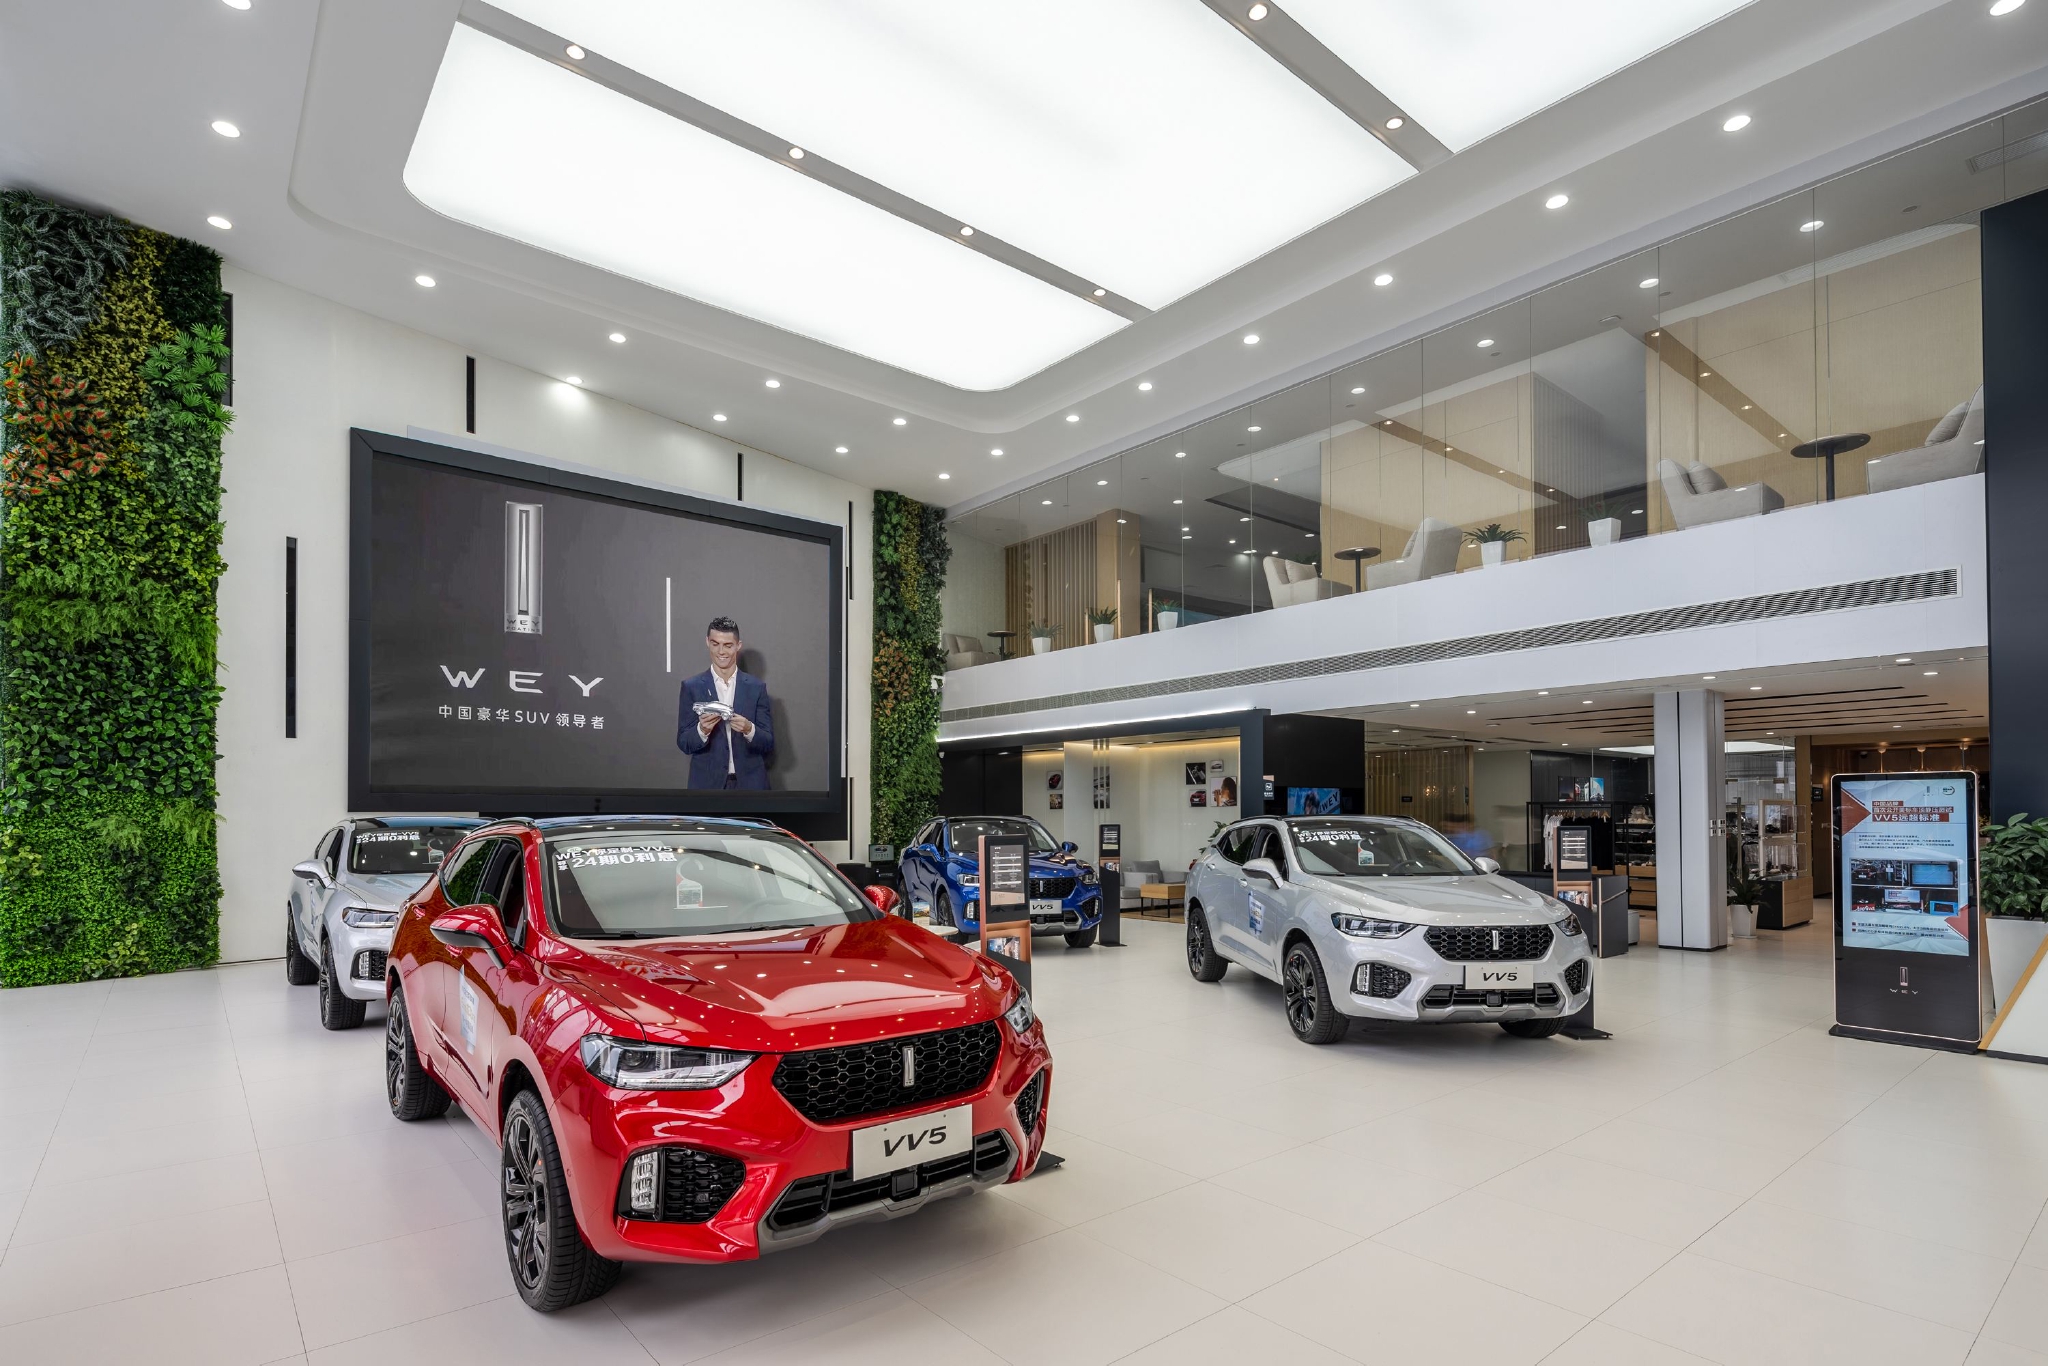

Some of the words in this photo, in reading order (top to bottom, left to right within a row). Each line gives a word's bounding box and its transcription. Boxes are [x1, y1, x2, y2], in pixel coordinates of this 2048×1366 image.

[438, 704, 605, 730] 中国豪华SUV领导者
[1483, 972, 1518, 982] VV5
[883, 1125, 948, 1158] VV5
